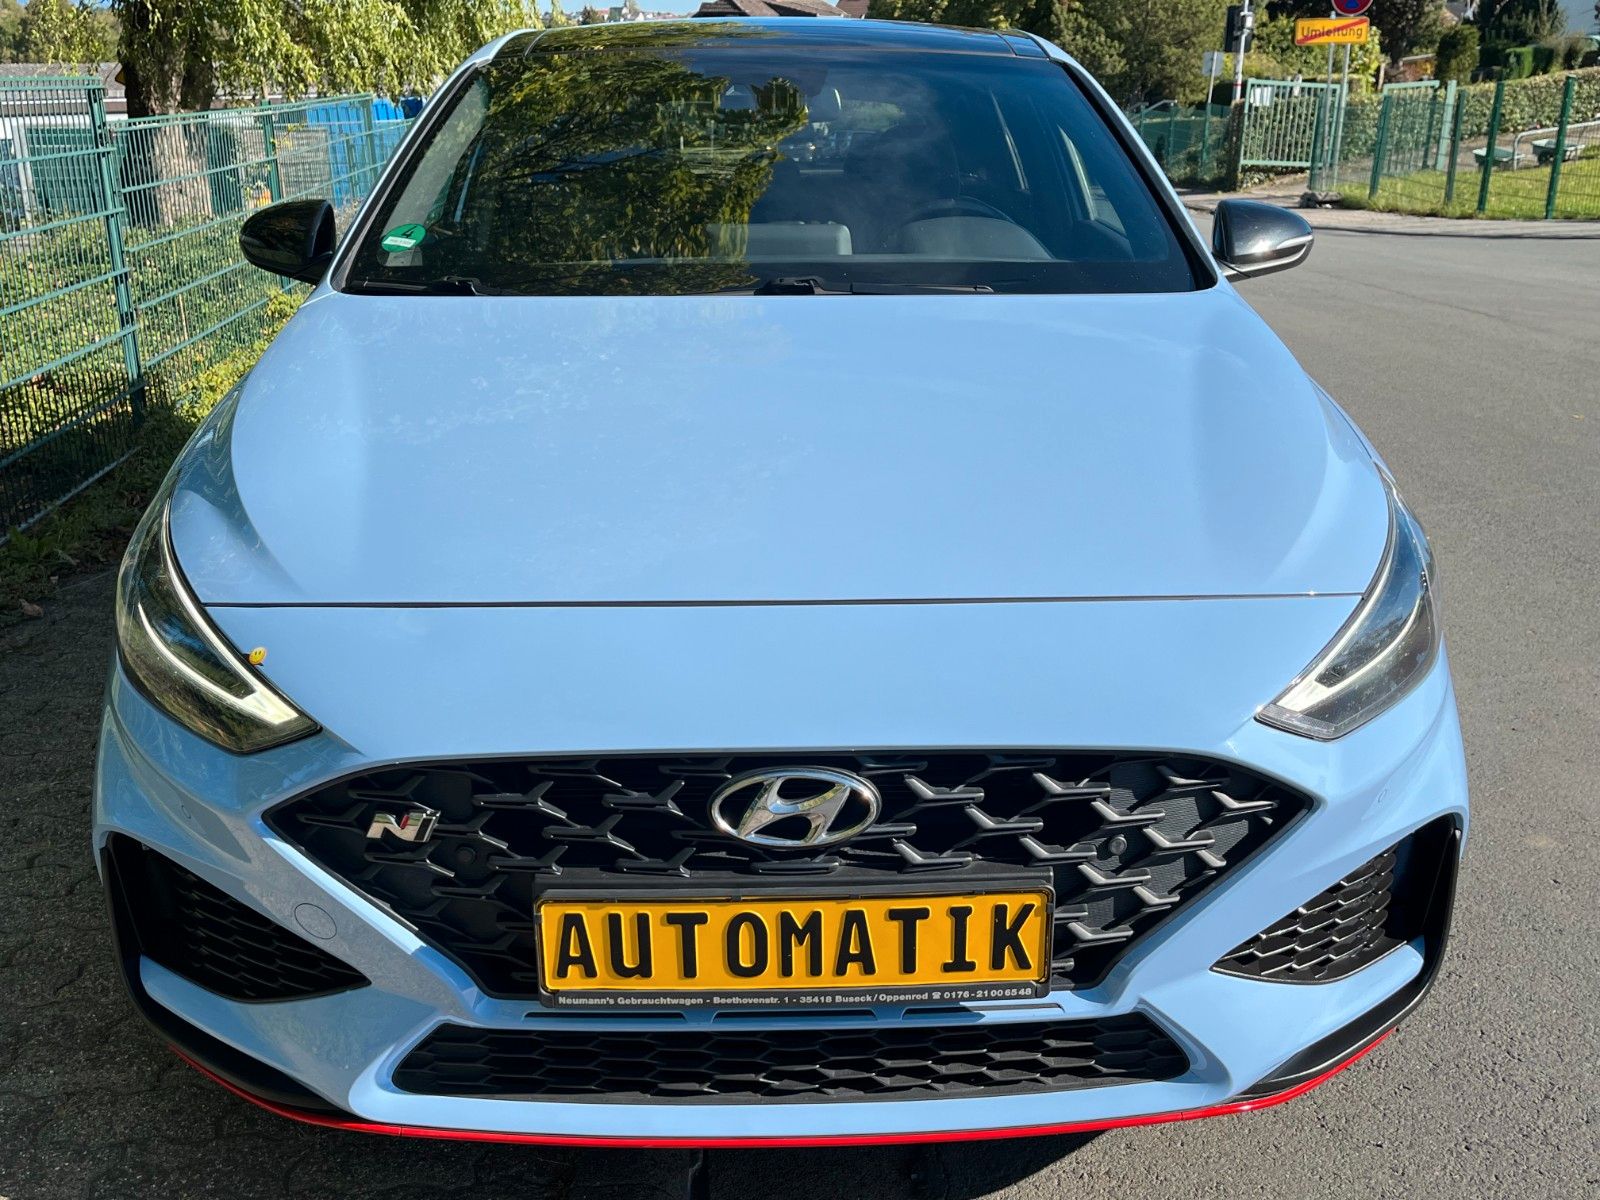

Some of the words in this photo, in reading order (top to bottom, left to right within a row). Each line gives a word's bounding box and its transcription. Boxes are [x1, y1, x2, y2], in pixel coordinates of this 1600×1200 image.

[1301, 26, 1363, 39] Umleitung
[556, 903, 1036, 979] AUTOMATIK
[558, 996, 615, 1005] Neumann's
[617, 996, 704, 1006] Gebrauchtwagen
[712, 996, 781, 1005] Beethovenstr.
[783, 996, 789, 1004] 1
[799, 995, 833, 1004] 35418
